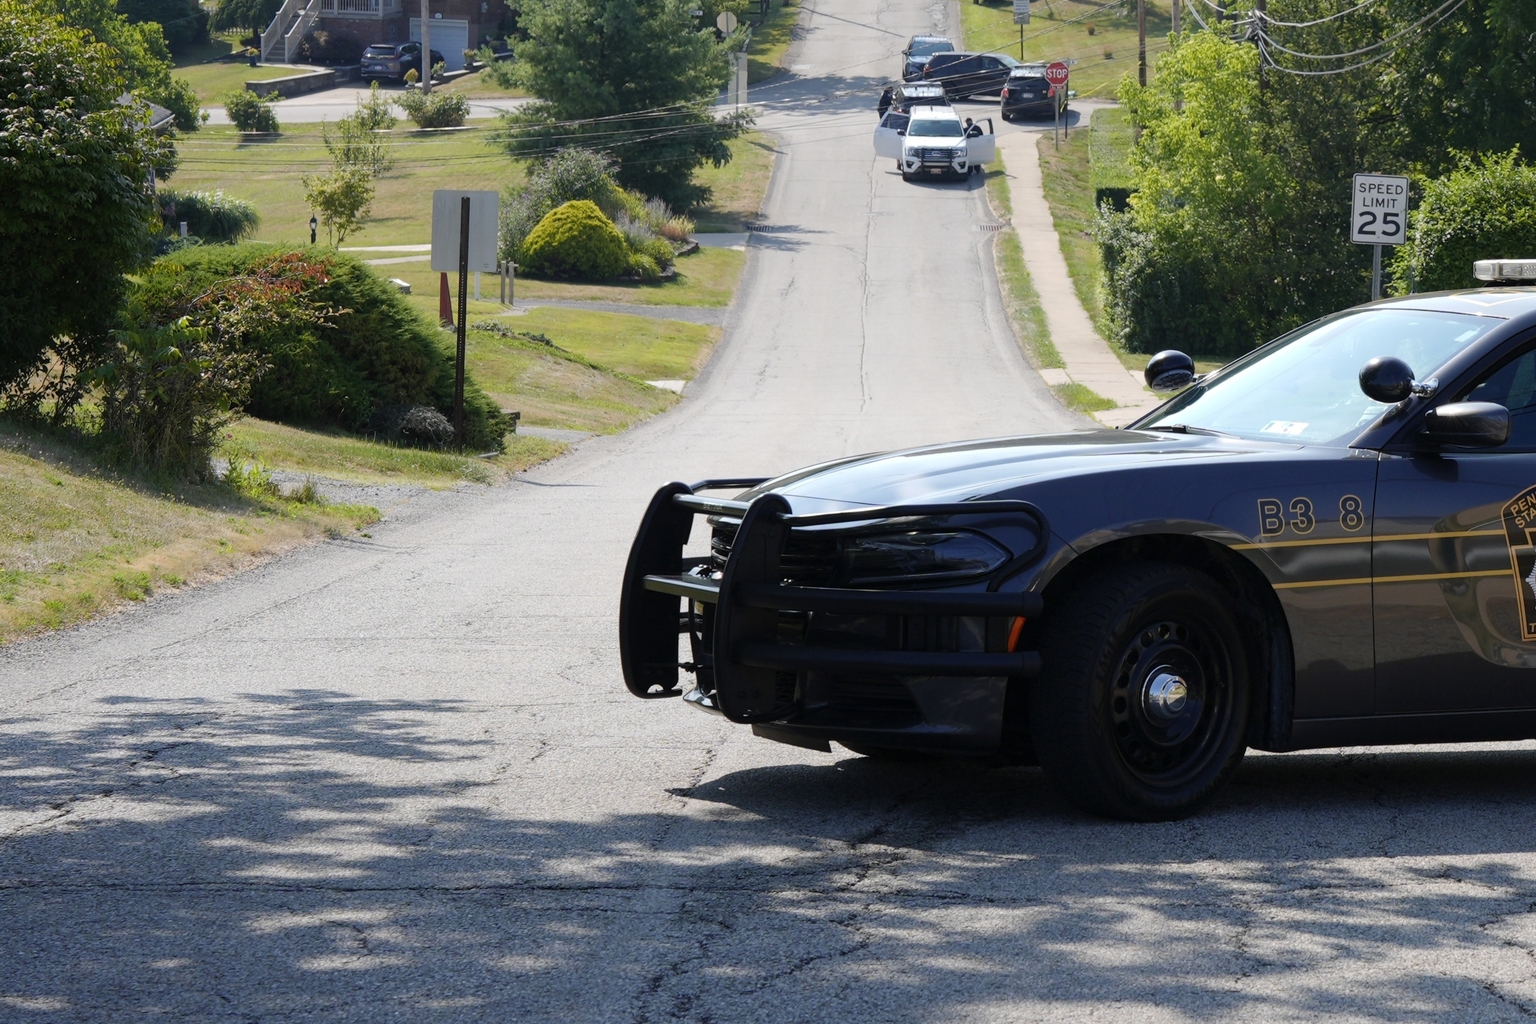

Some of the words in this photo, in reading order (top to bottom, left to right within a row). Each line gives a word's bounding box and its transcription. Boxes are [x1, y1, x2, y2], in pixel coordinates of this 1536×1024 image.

[1047, 69, 1068, 79] STOP
[1358, 182, 1404, 195] SPEED
[1362, 197, 1398, 209] LIMIT
[1357, 211, 1401, 236] 25
[1257, 497, 1316, 537] B3
[1339, 494, 1365, 532] 8
